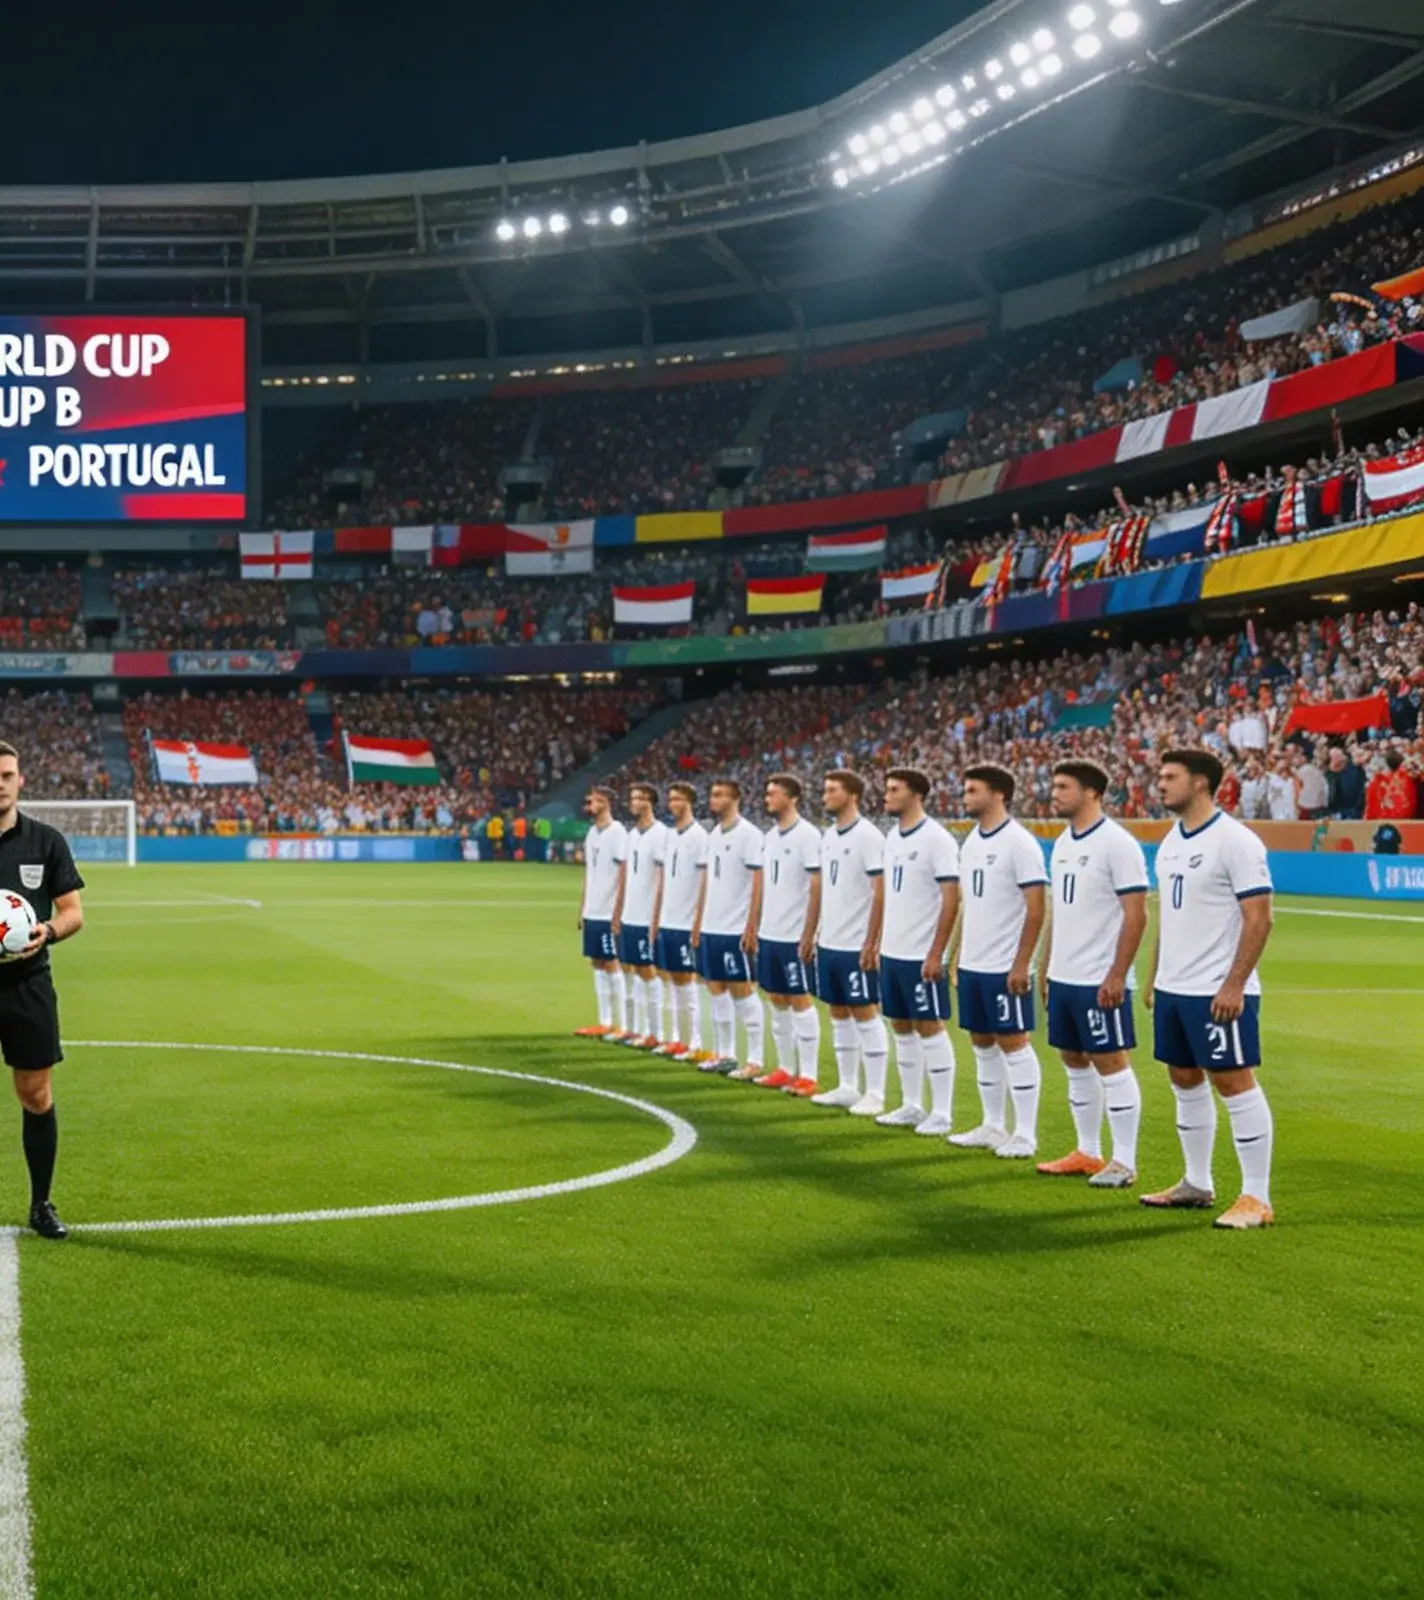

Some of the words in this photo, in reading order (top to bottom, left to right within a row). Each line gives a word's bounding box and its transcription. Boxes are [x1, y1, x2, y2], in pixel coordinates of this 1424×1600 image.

[83, 333, 170, 377] CUP
[56, 387, 82, 427] B
[29, 443, 226, 487] PORTUGAL
